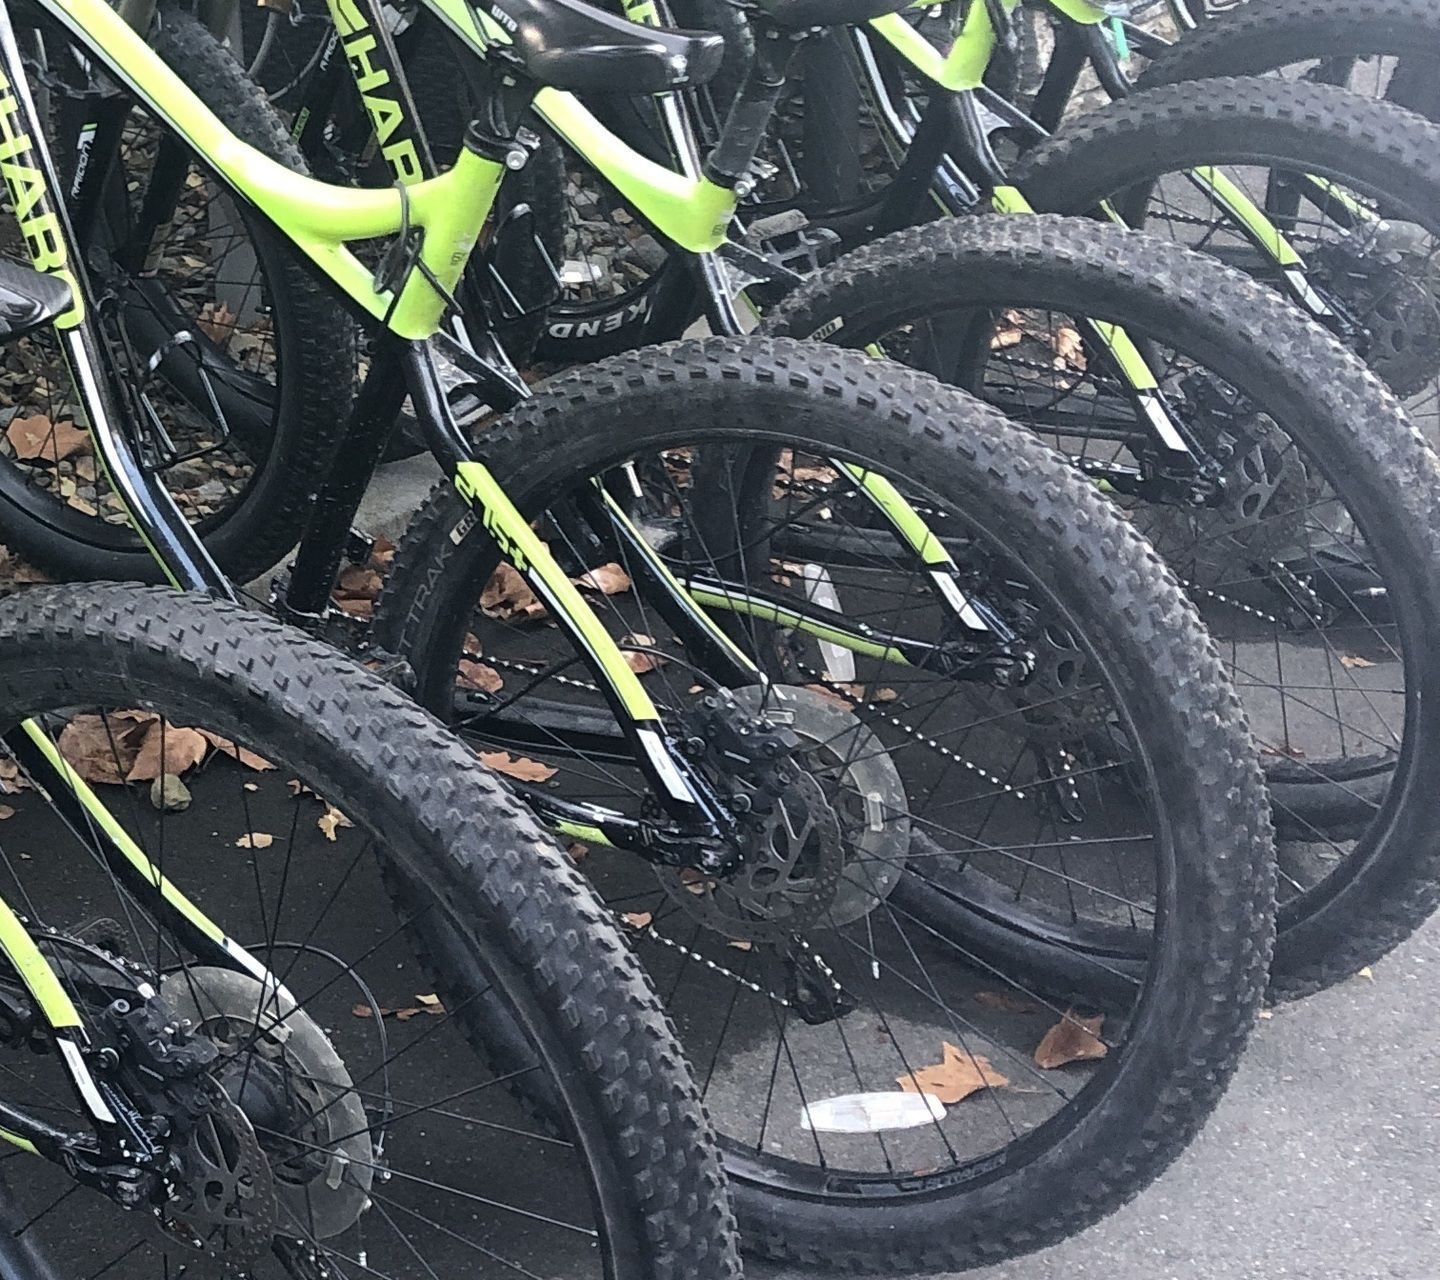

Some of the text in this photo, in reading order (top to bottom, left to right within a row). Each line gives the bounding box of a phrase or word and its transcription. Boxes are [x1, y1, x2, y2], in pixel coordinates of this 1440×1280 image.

[344, 34, 424, 187] HAR
[549, 296, 653, 339] KEND
[812, 322, 836, 341] RID
